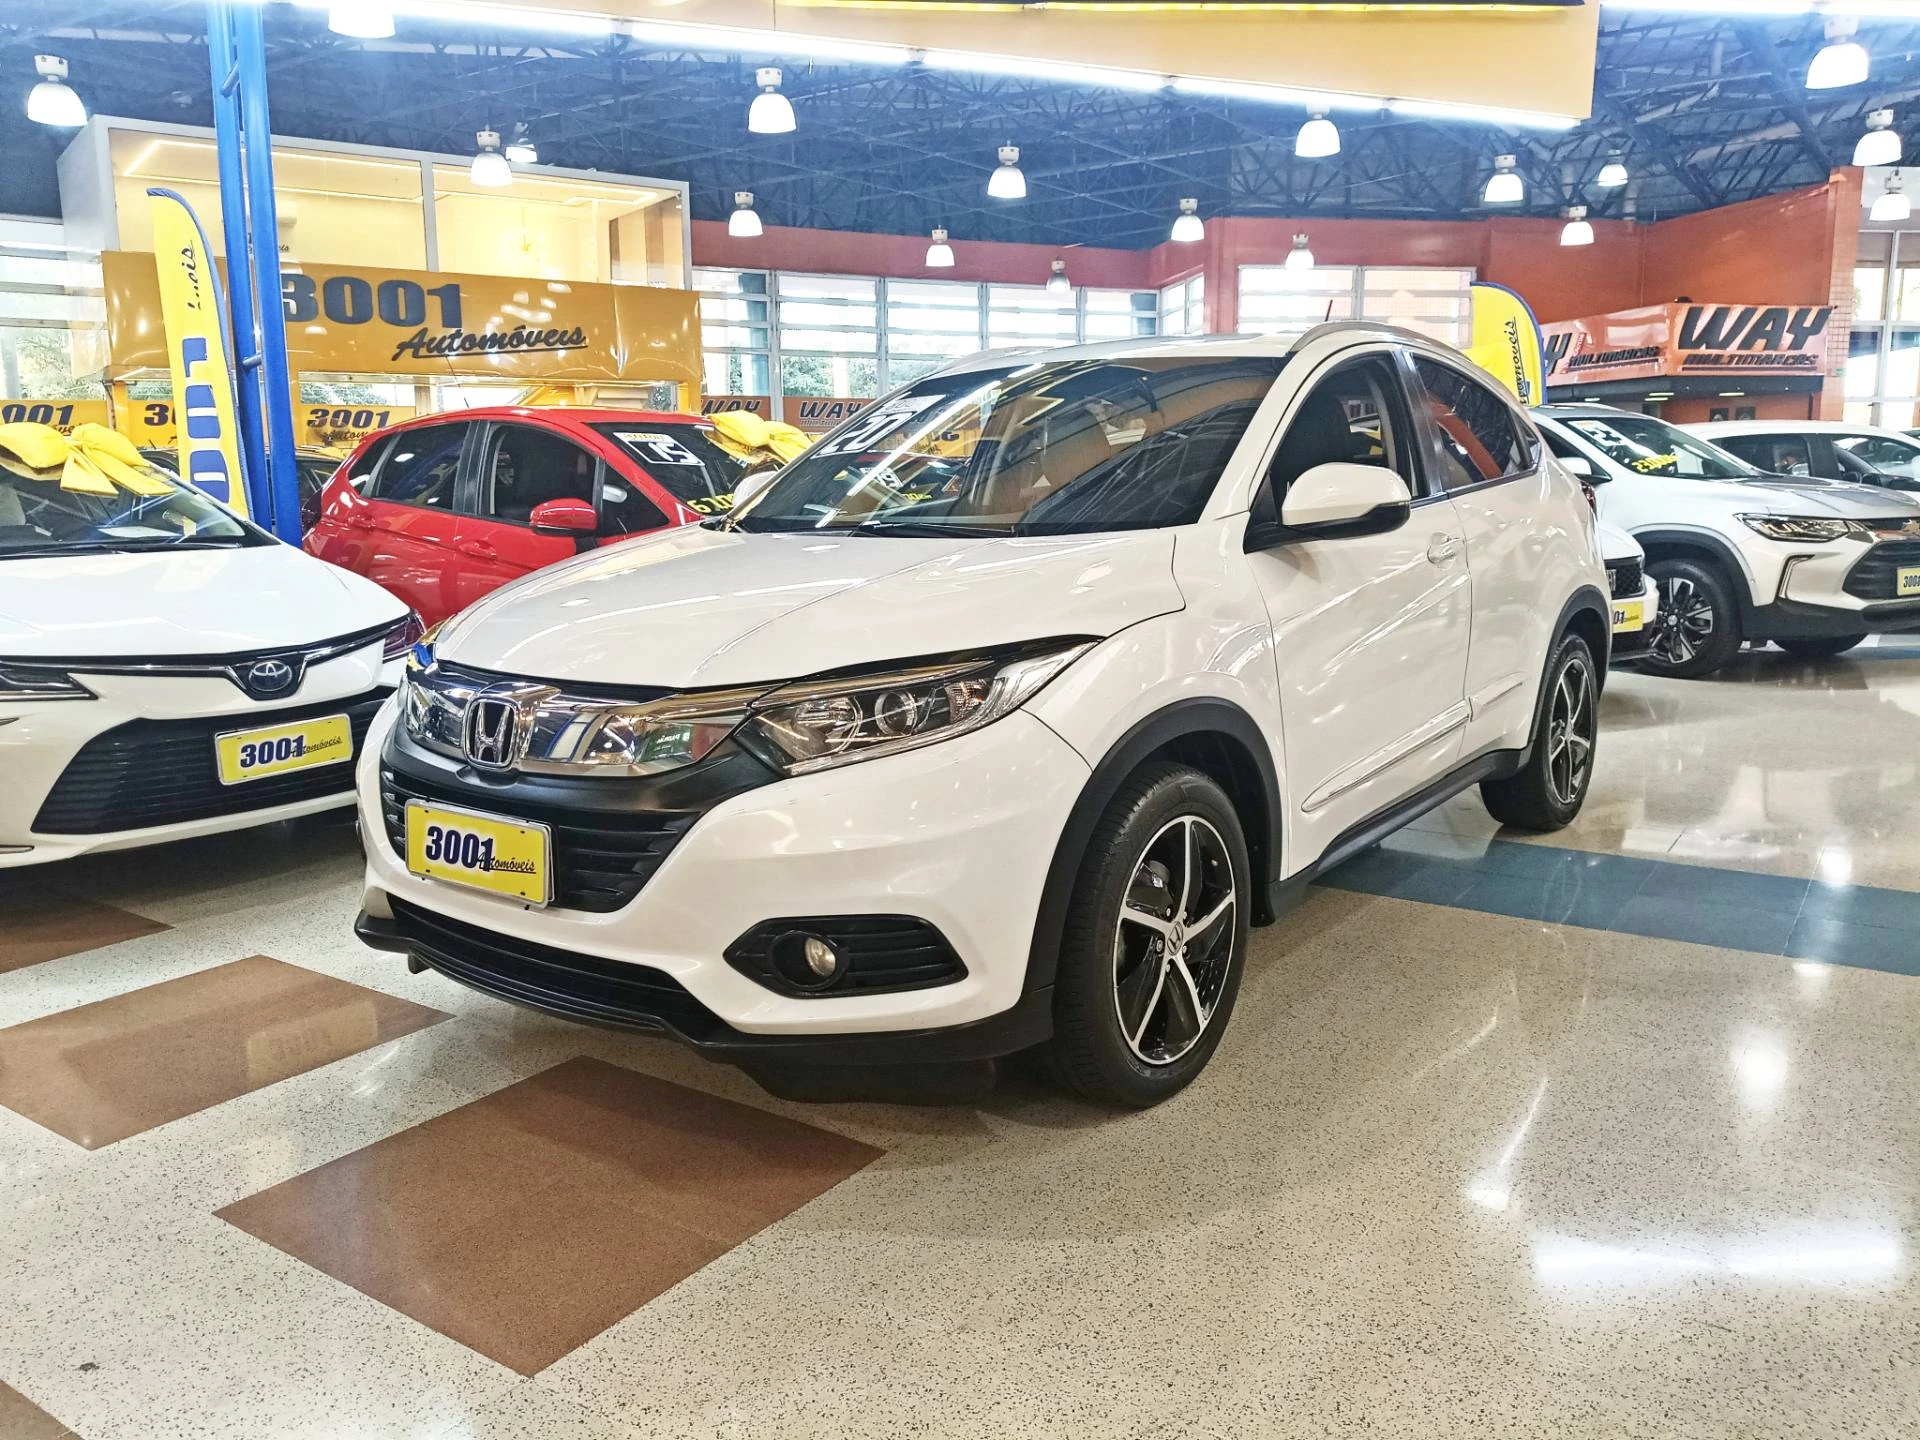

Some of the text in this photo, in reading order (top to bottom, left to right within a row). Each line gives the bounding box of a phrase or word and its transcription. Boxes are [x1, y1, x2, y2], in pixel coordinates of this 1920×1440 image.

[281, 273, 461, 328] 3001
[391, 325, 588, 361] Automóveis
[1678, 306, 1833, 351] WAY
[2, 404, 74, 425] 001
[307, 409, 390, 428] 3001
[800, 401, 863, 419] WAY
[820, 411, 914, 456] 20
[648, 442, 700, 464] 15
[240, 734, 304, 768] 3001
[425, 825, 494, 872] 3001
